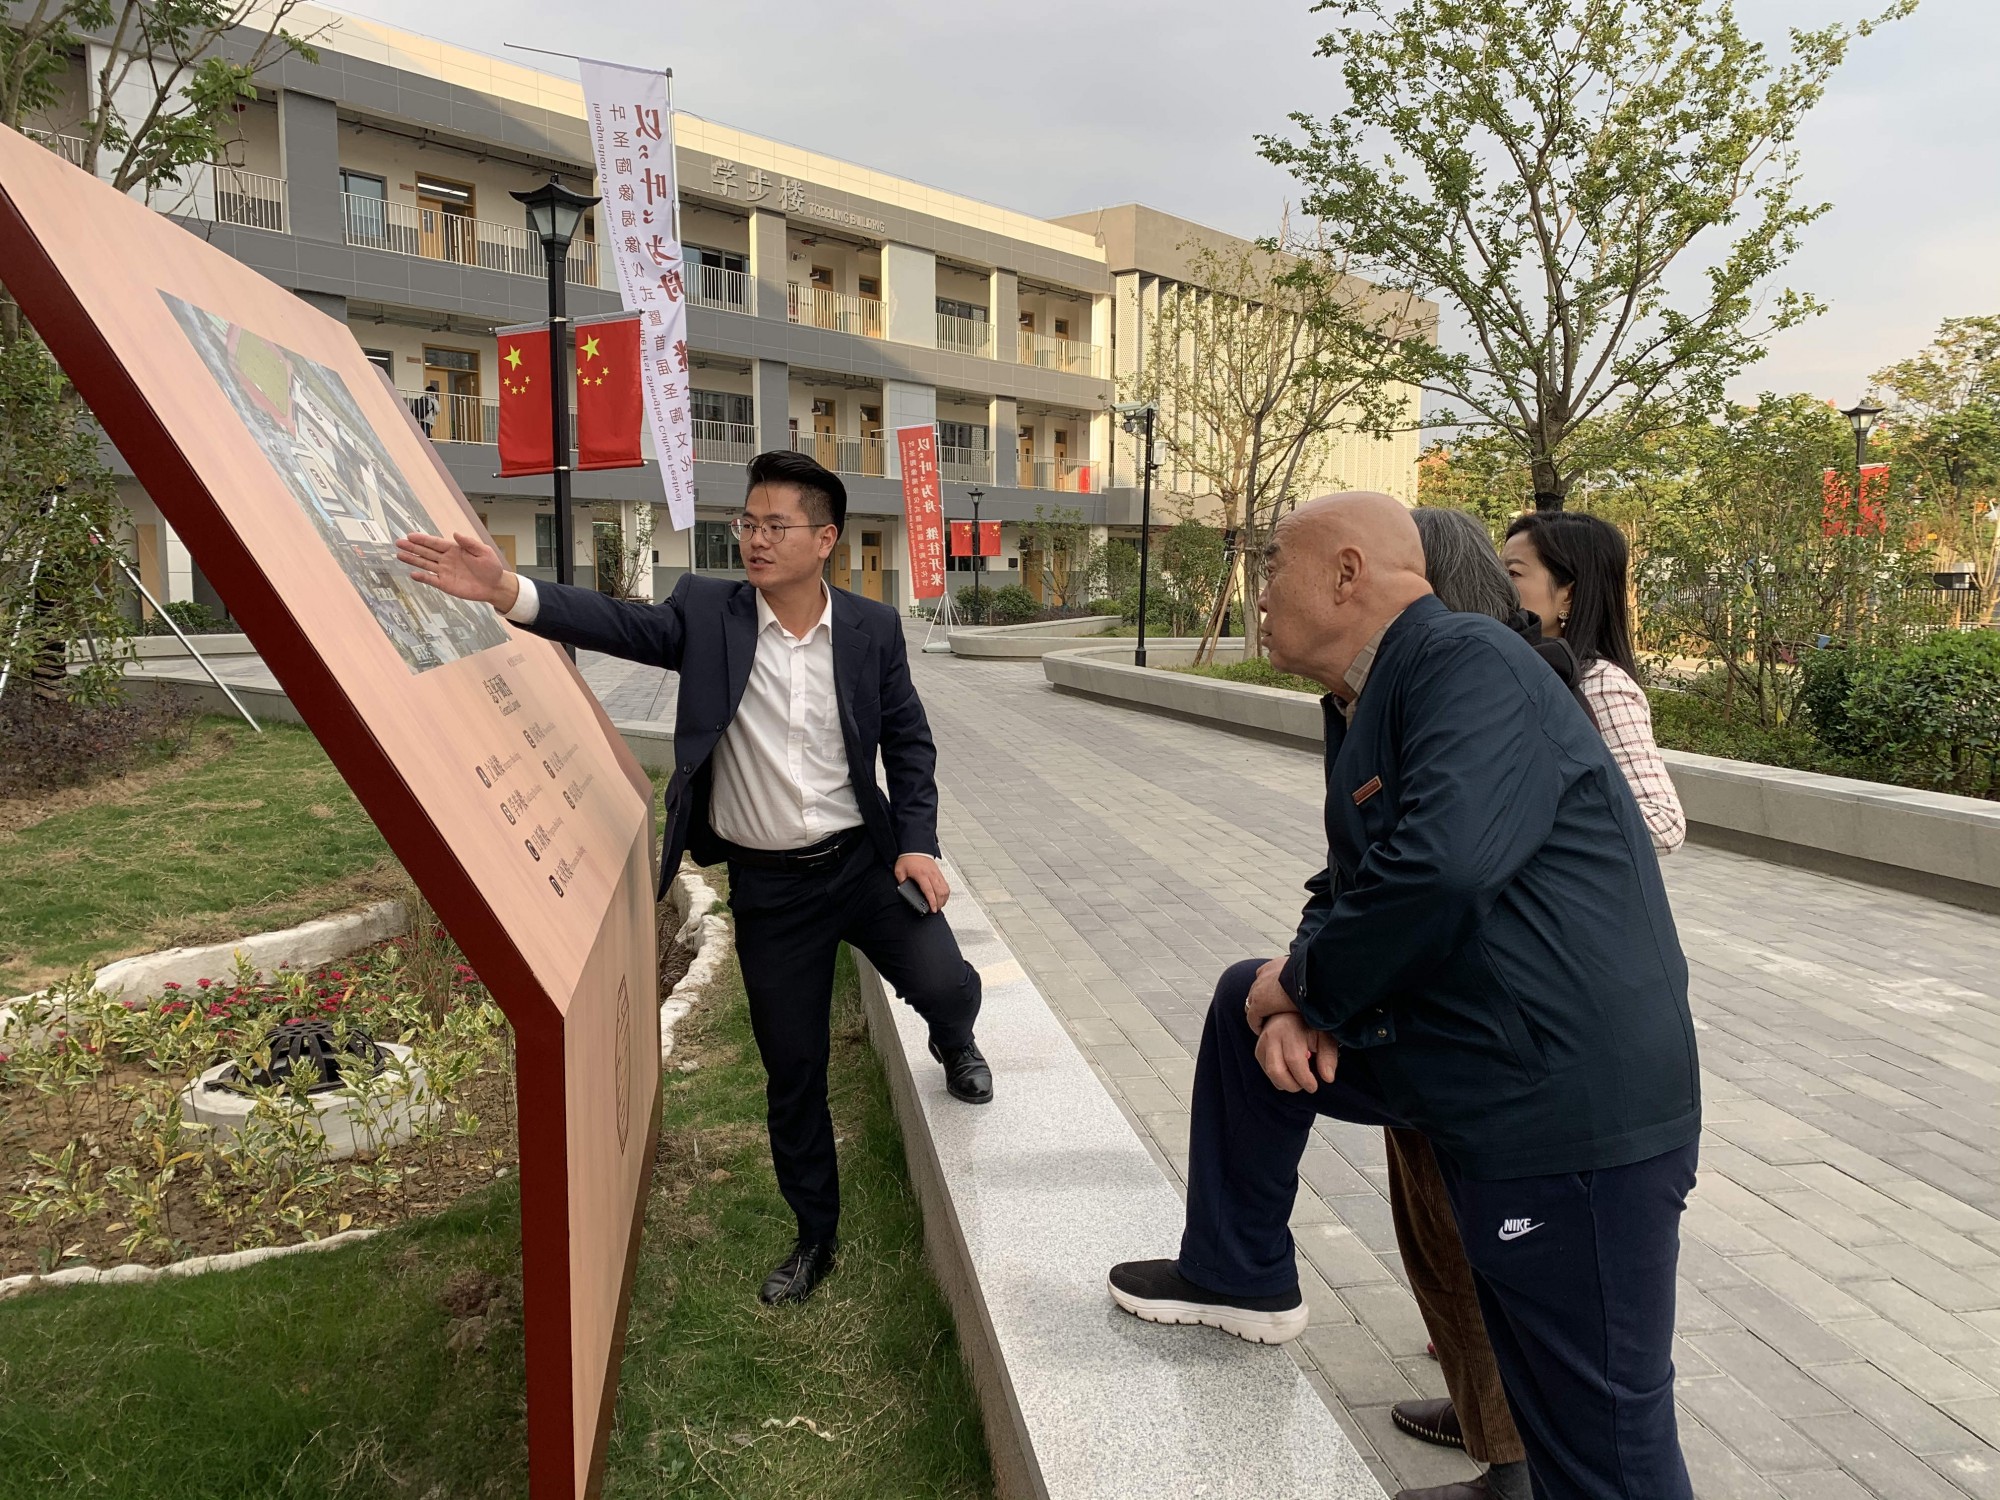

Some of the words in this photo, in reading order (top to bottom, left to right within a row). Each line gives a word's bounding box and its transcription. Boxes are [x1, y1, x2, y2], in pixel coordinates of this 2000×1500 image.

[711, 159, 805, 215] 学步楼
[850, 213, 886, 233] BUILDING
[482, 674, 512, 704] 总平面图
[502, 805, 515, 823] B
[527, 841, 539, 860] C
[550, 878, 562, 896] D
[1504, 1218, 1532, 1232] NIKE
